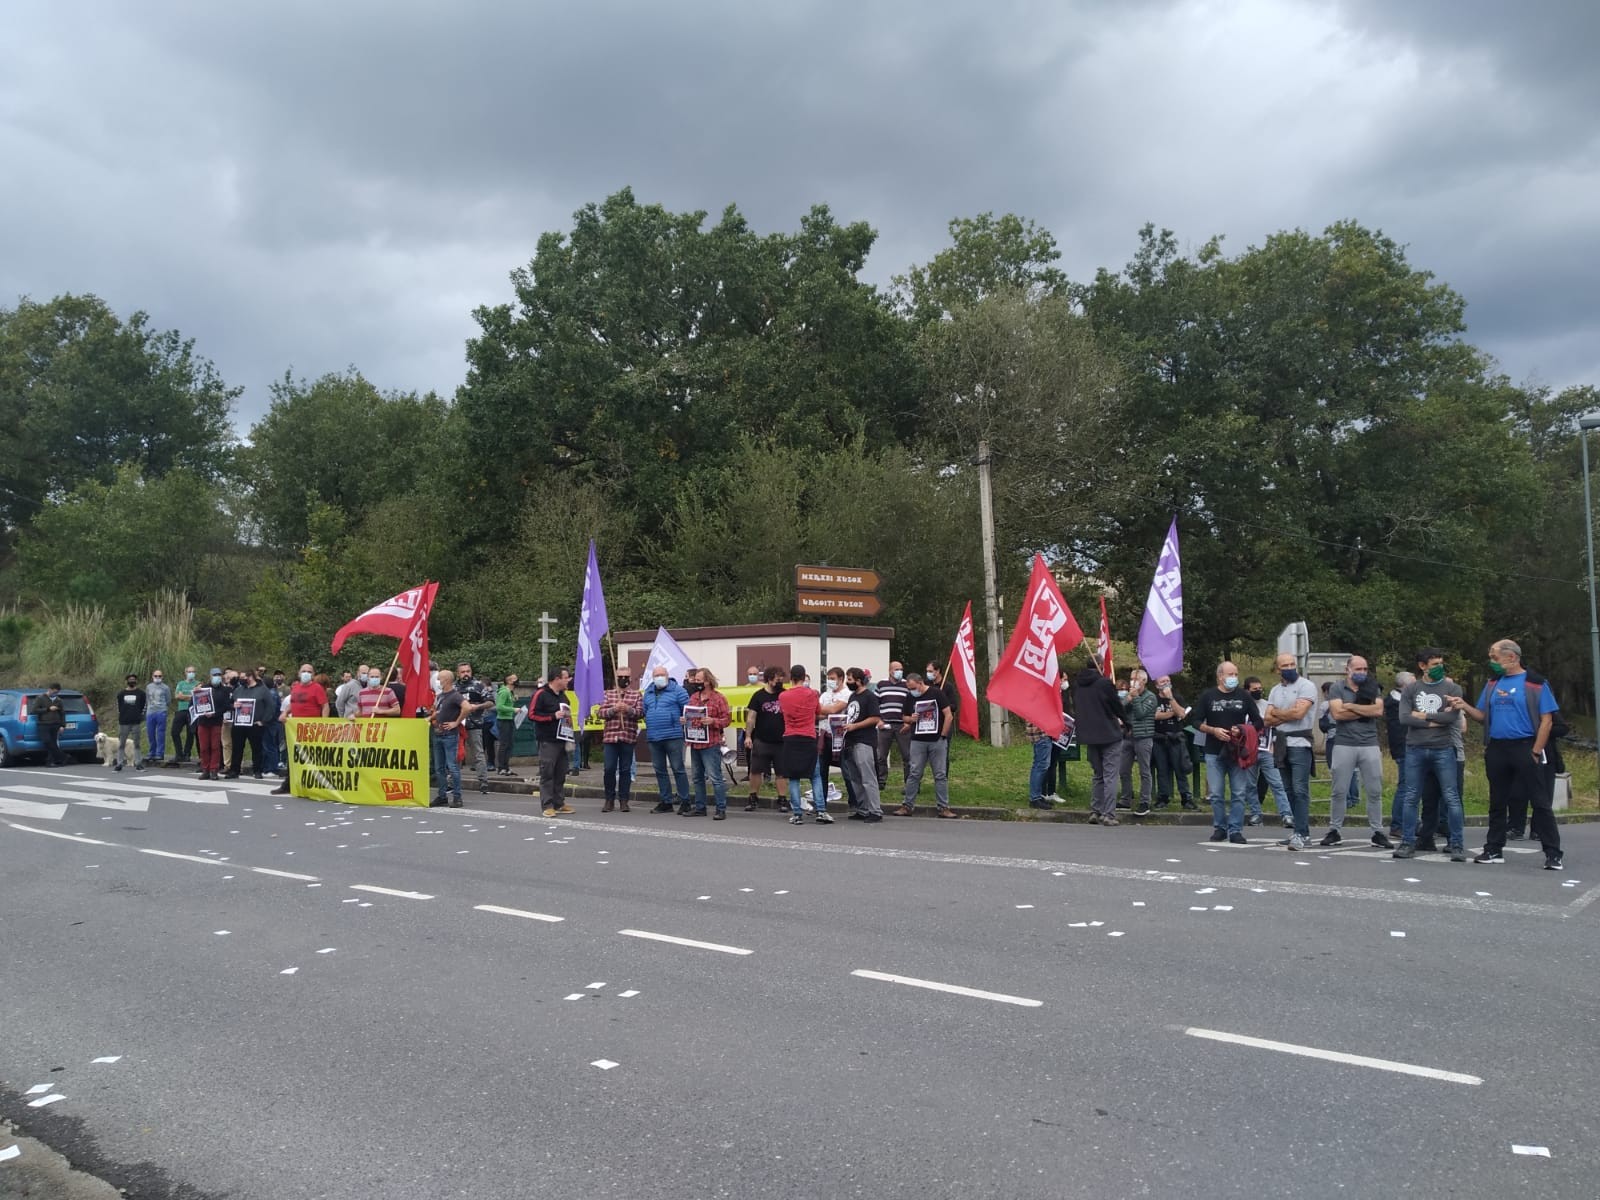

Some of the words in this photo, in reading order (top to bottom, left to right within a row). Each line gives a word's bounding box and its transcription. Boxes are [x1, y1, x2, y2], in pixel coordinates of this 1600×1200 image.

[293, 744, 344, 767] BORROKA
[347, 747, 420, 771] SINDIKALA
[382, 780, 413, 796] LAB
